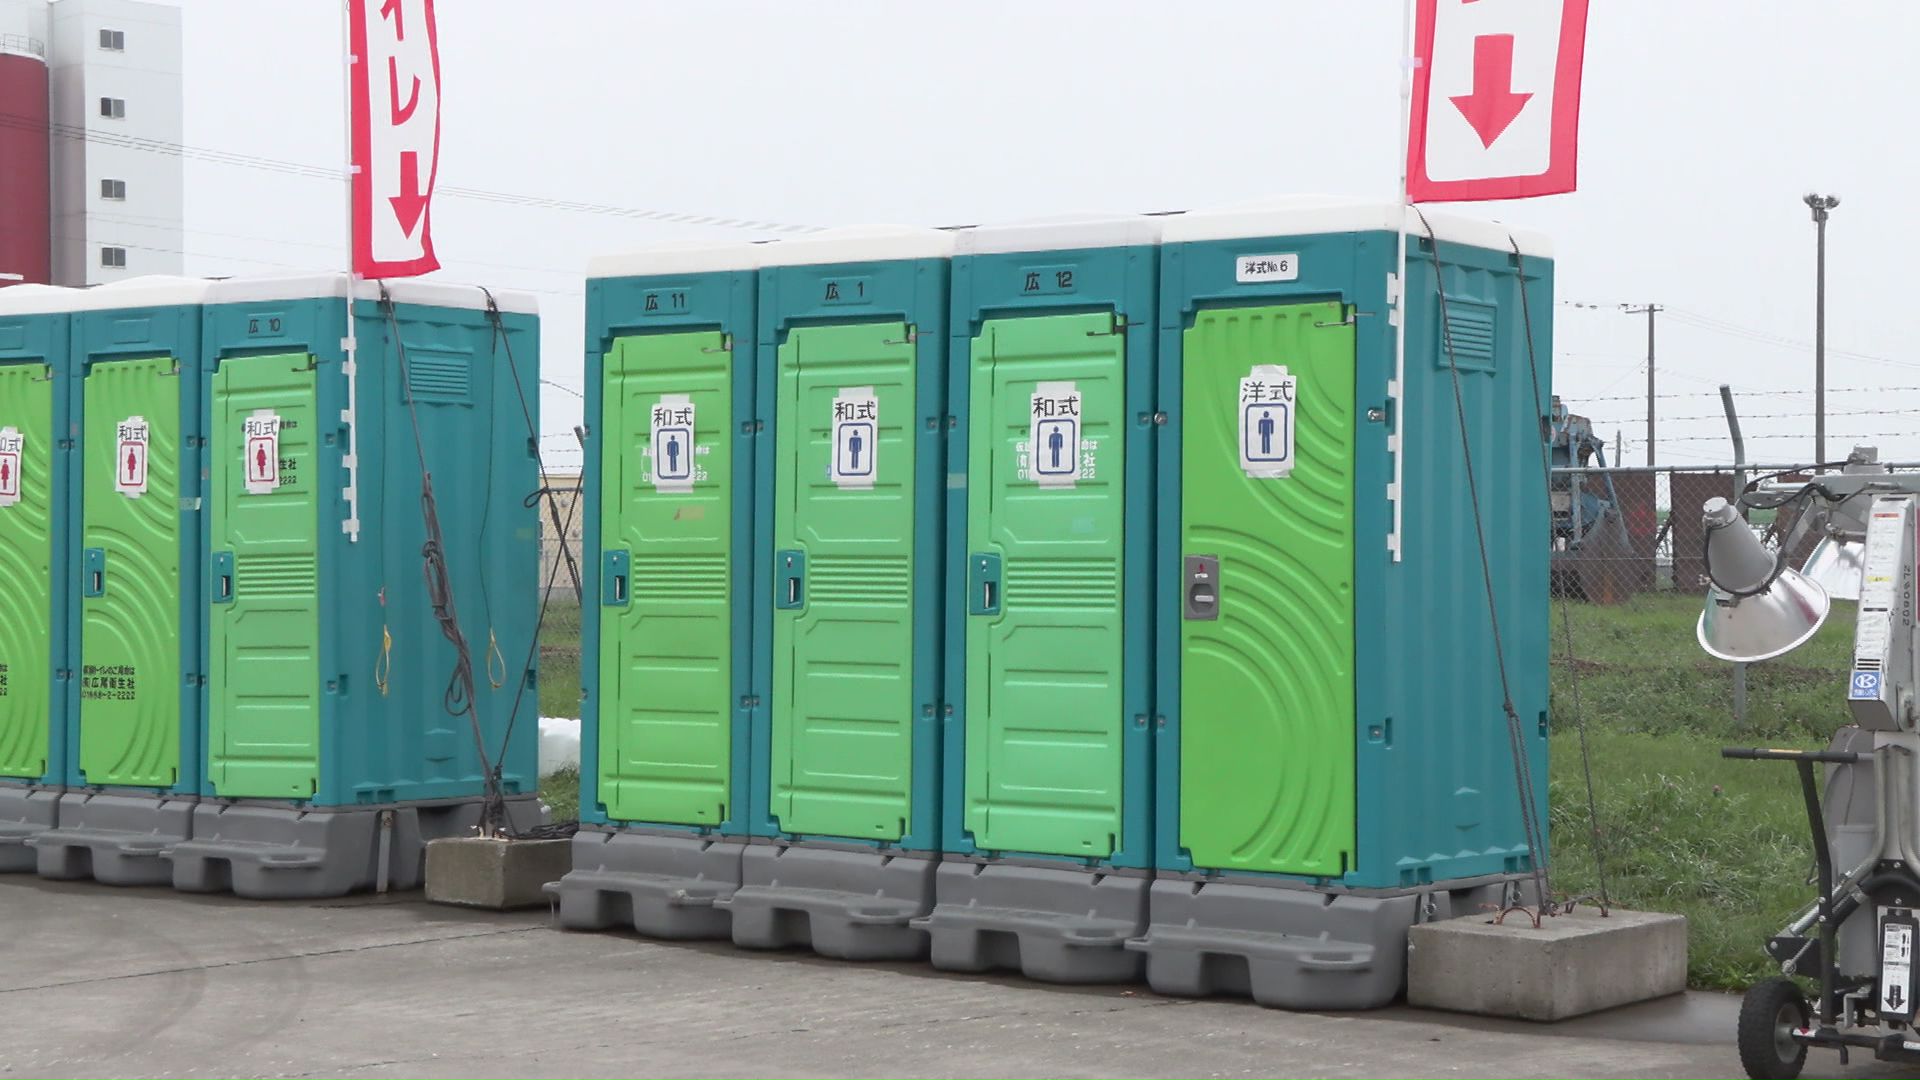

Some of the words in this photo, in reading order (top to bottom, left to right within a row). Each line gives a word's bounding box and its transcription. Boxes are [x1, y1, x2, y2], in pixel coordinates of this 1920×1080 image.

[825, 281, 841, 301] 広
[857, 281, 864, 298] 1
[1024, 272, 1041, 292] 広
[1056, 271, 1073, 288] 12
[645, 293, 659, 312] 広
[671, 293, 685, 309] 11
[269, 317, 281, 332] 10
[1242, 381, 1293, 402] 洋式
[654, 407, 692, 427] 和式
[834, 400, 876, 421] 和式
[1033, 396, 1079, 418] 和式
[119, 425, 147, 442] 和式
[247, 419, 278, 437] 和式
